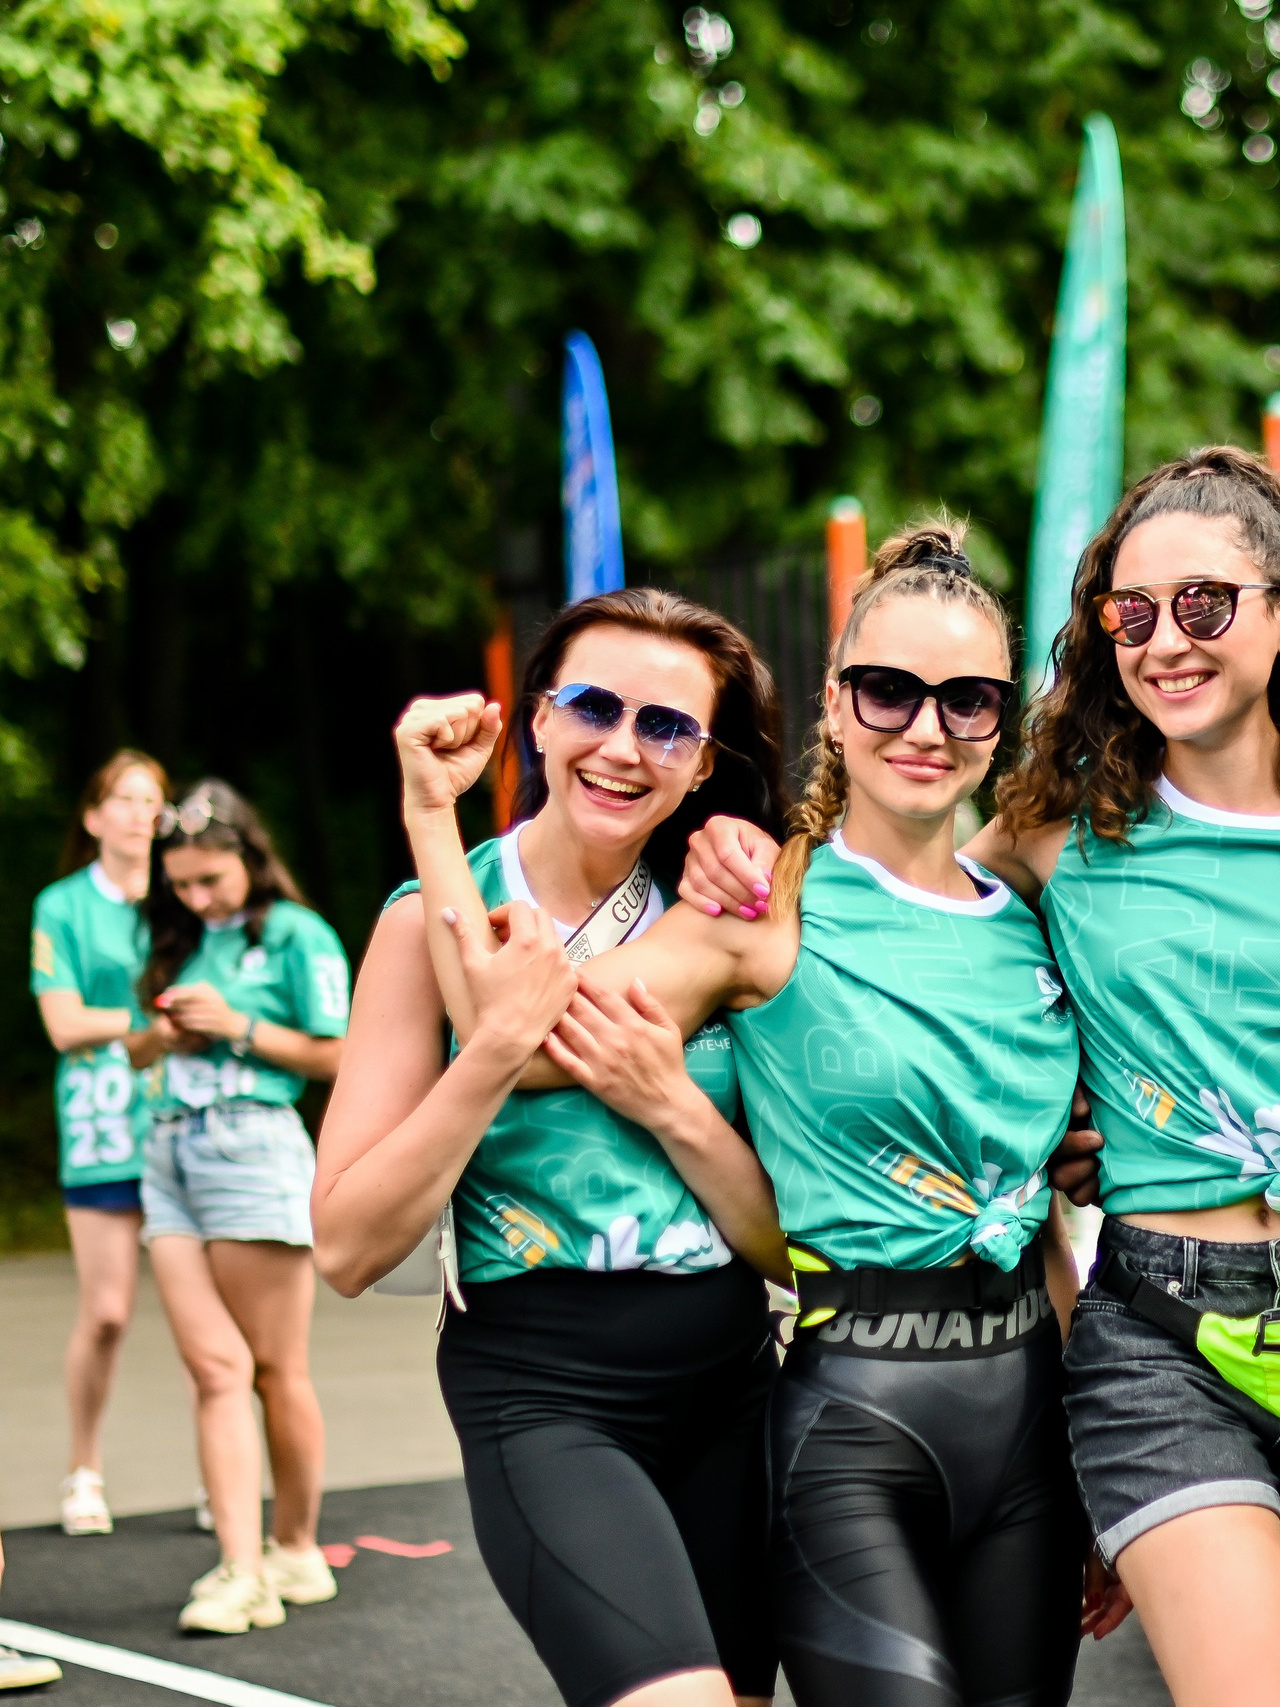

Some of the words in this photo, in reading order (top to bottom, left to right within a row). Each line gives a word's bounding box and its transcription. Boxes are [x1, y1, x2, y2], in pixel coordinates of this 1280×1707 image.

[611, 864, 649, 924] GUESS
[567, 938, 588, 959] GUESS
[64, 1065, 133, 1118] 20
[67, 1115, 135, 1169] 23
[817, 1310, 974, 1349] BONA
